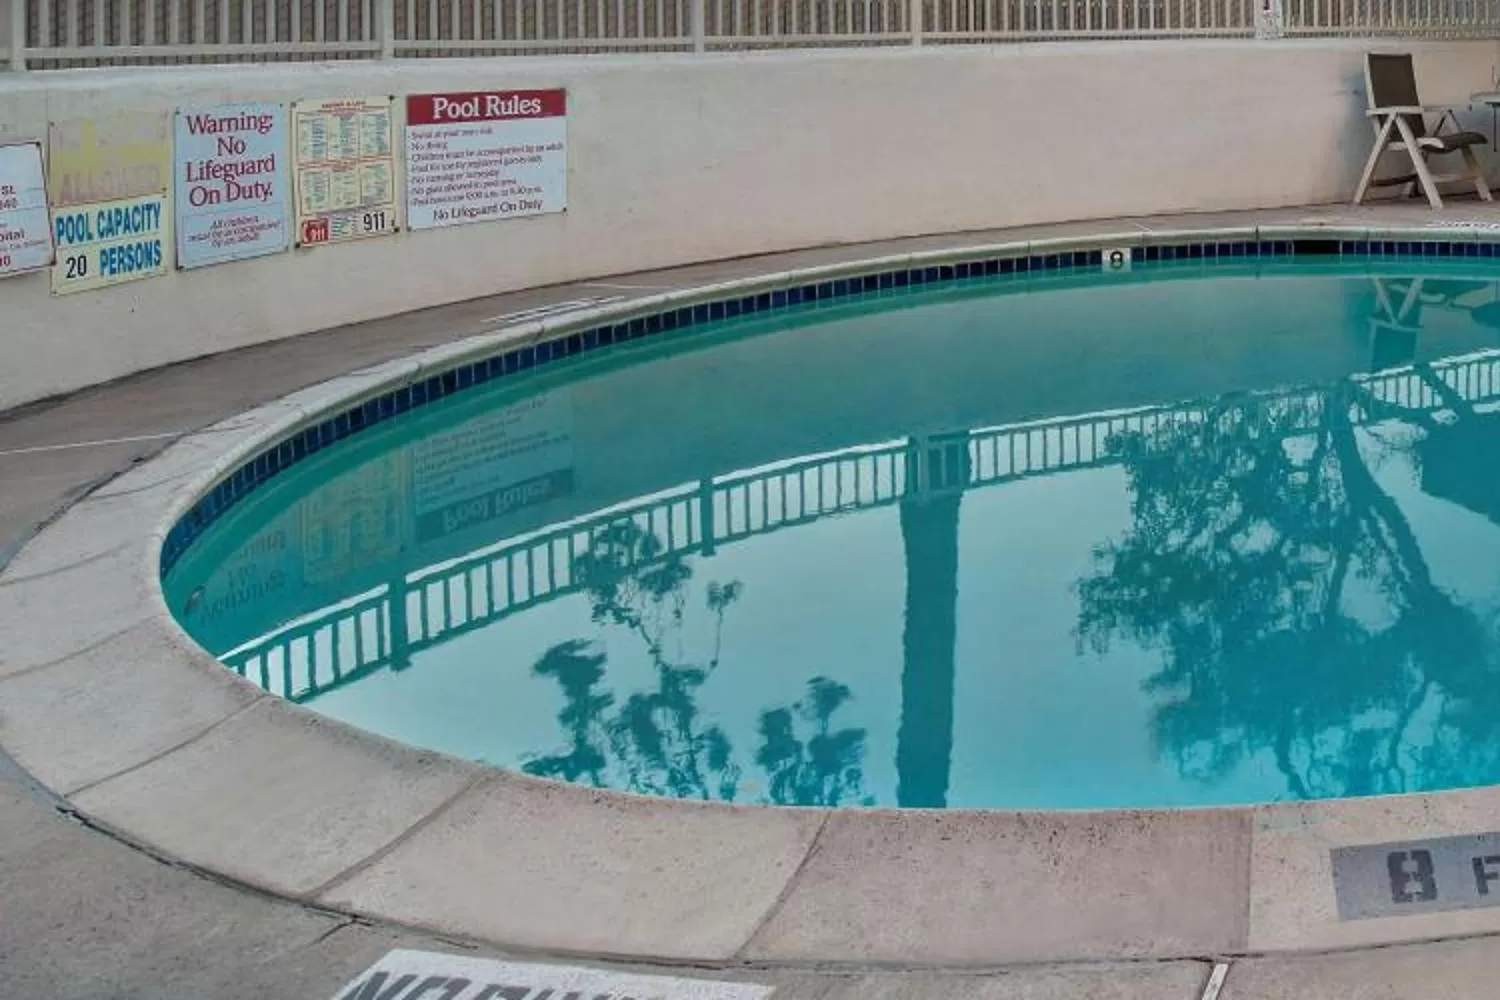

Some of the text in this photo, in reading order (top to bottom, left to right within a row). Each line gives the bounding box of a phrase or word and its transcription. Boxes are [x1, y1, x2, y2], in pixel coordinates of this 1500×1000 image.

[432, 94, 541, 119] Pool Rules
[217, 136, 246, 156] No
[185, 152, 275, 182] Lifeguard
[189, 181, 273, 207] On Duty.
[363, 211, 385, 231] 911
[433, 199, 543, 220] No Lifeguard On Duty
[56, 201, 161, 246] POOL CAPACITY
[66, 239, 161, 279] 20 PERSONS
[1387, 849, 1437, 904] 8
